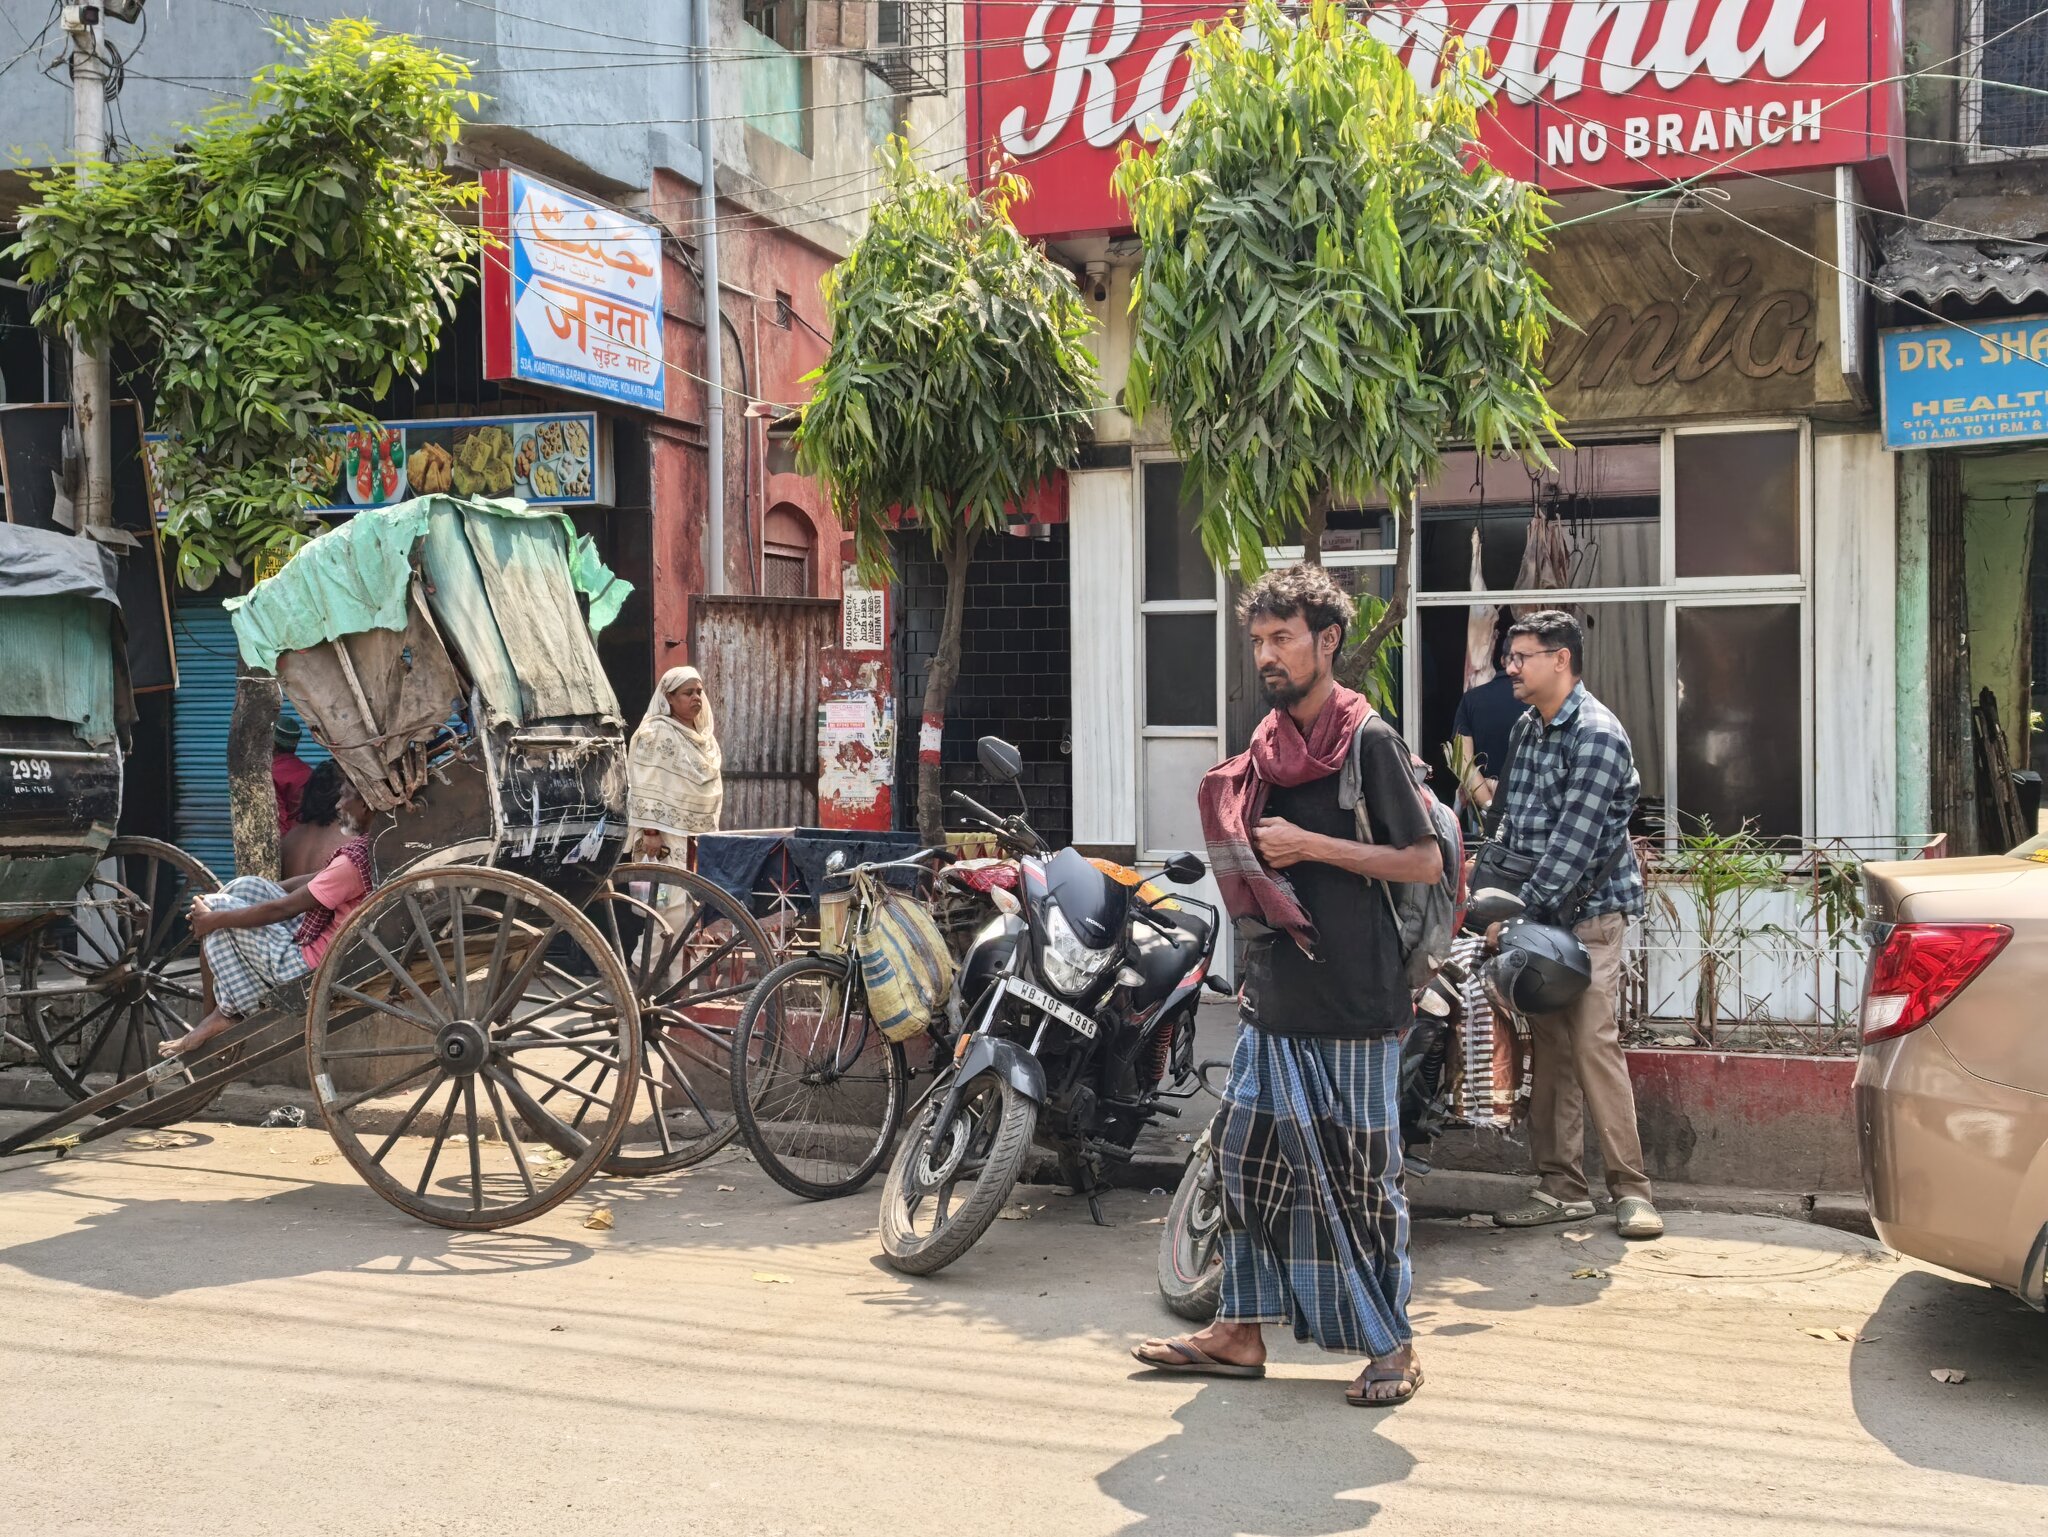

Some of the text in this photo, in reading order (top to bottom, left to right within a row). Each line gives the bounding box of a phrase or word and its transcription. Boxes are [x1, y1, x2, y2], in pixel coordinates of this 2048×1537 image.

[1548, 98, 1822, 165] NO BRANCH
[538, 279, 649, 355] जनता
[1897, 338, 1964, 372] DR.
[1912, 390, 2048, 417] HEALT
[1940, 409, 2042, 426] KABITIRTHA
[1910, 420, 2042, 440] 10 A.M. TO 1 P.M. &
[874, 595, 882, 646] LOSS WEIGHT
[10, 759, 52, 780] 2998
[1020, 984, 1095, 1035] WB 10F 1986
